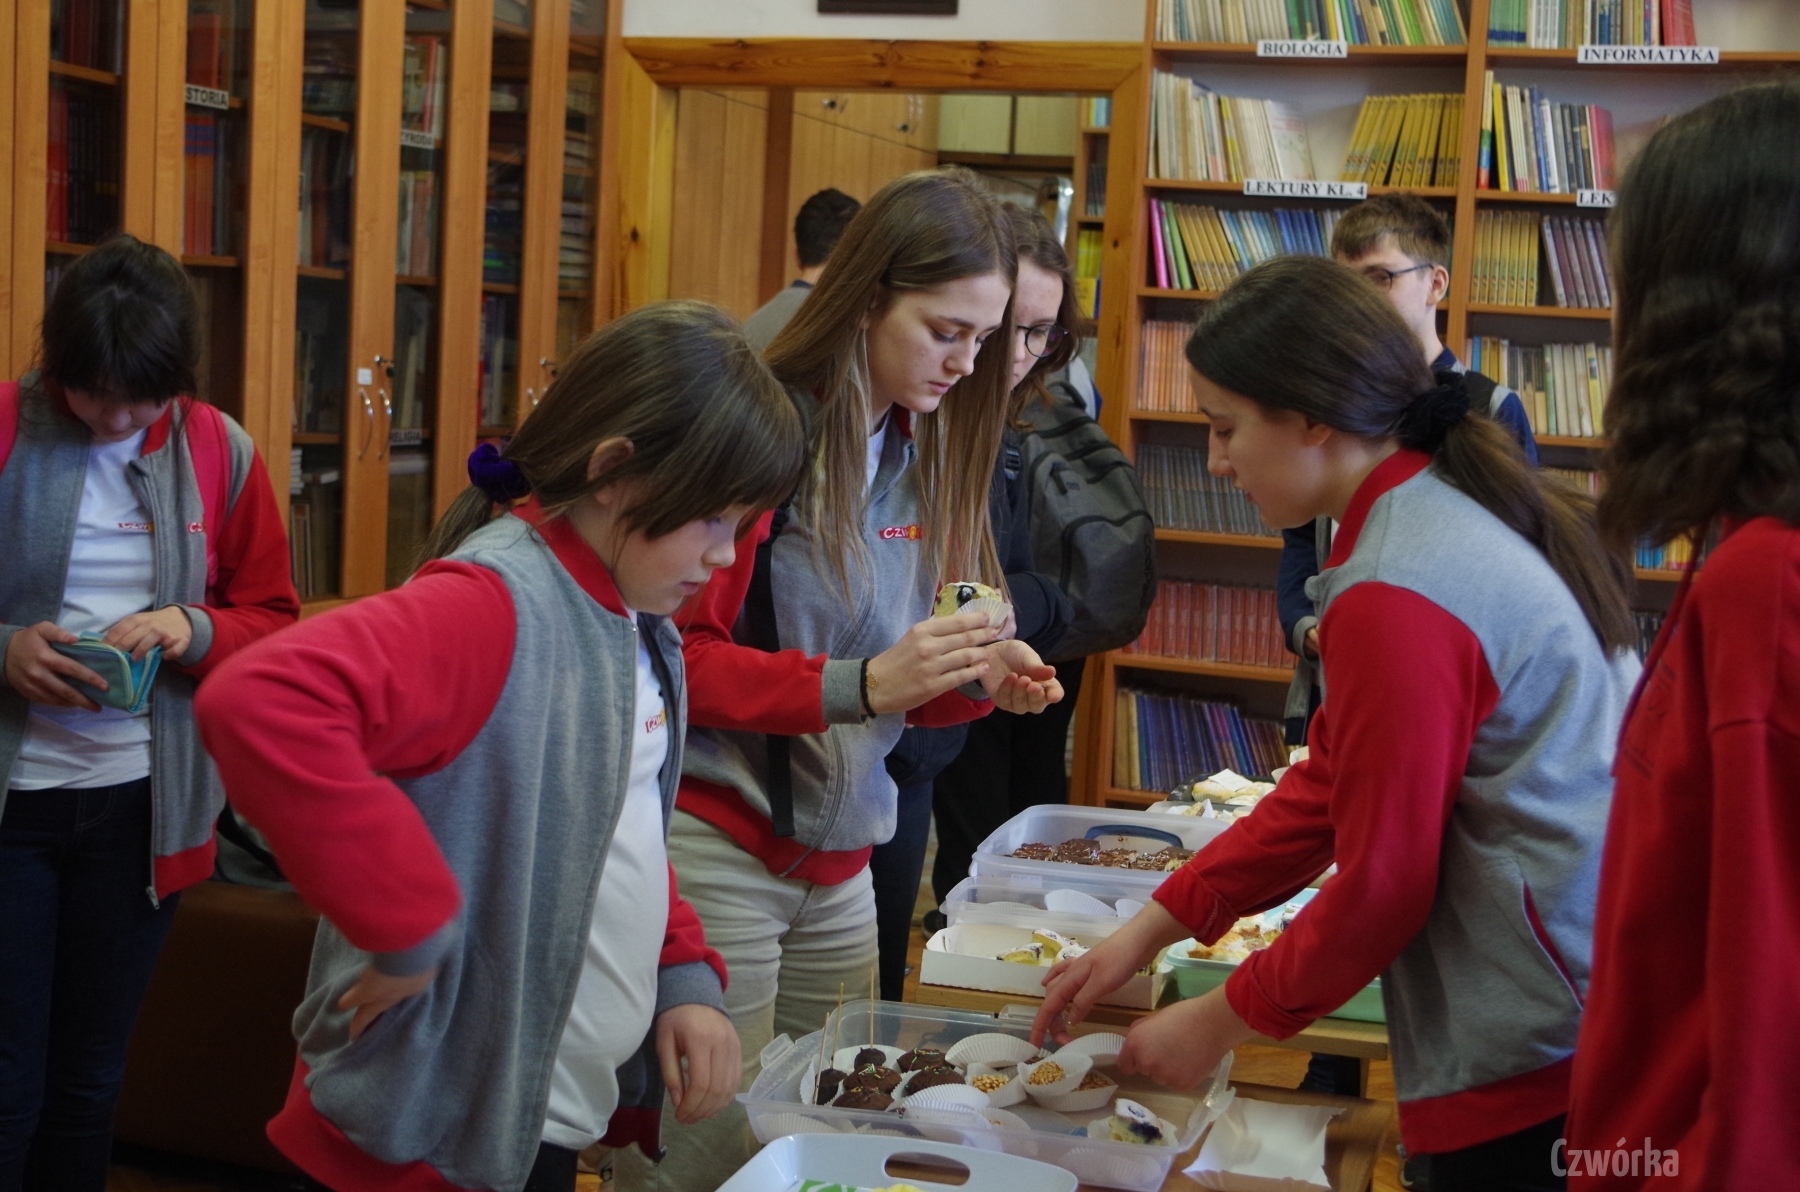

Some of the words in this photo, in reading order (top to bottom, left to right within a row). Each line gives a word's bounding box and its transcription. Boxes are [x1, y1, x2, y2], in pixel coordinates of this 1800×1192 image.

[1262, 42, 1343, 55] BIOLOGIA
[1583, 48, 1716, 62] INFORMATYKA
[186, 87, 227, 105] STORIA
[1246, 181, 1324, 195] LEKTURY
[1327, 183, 1353, 196] KL.
[1356, 185, 1365, 197] 4
[1579, 193, 1613, 205] LEK
